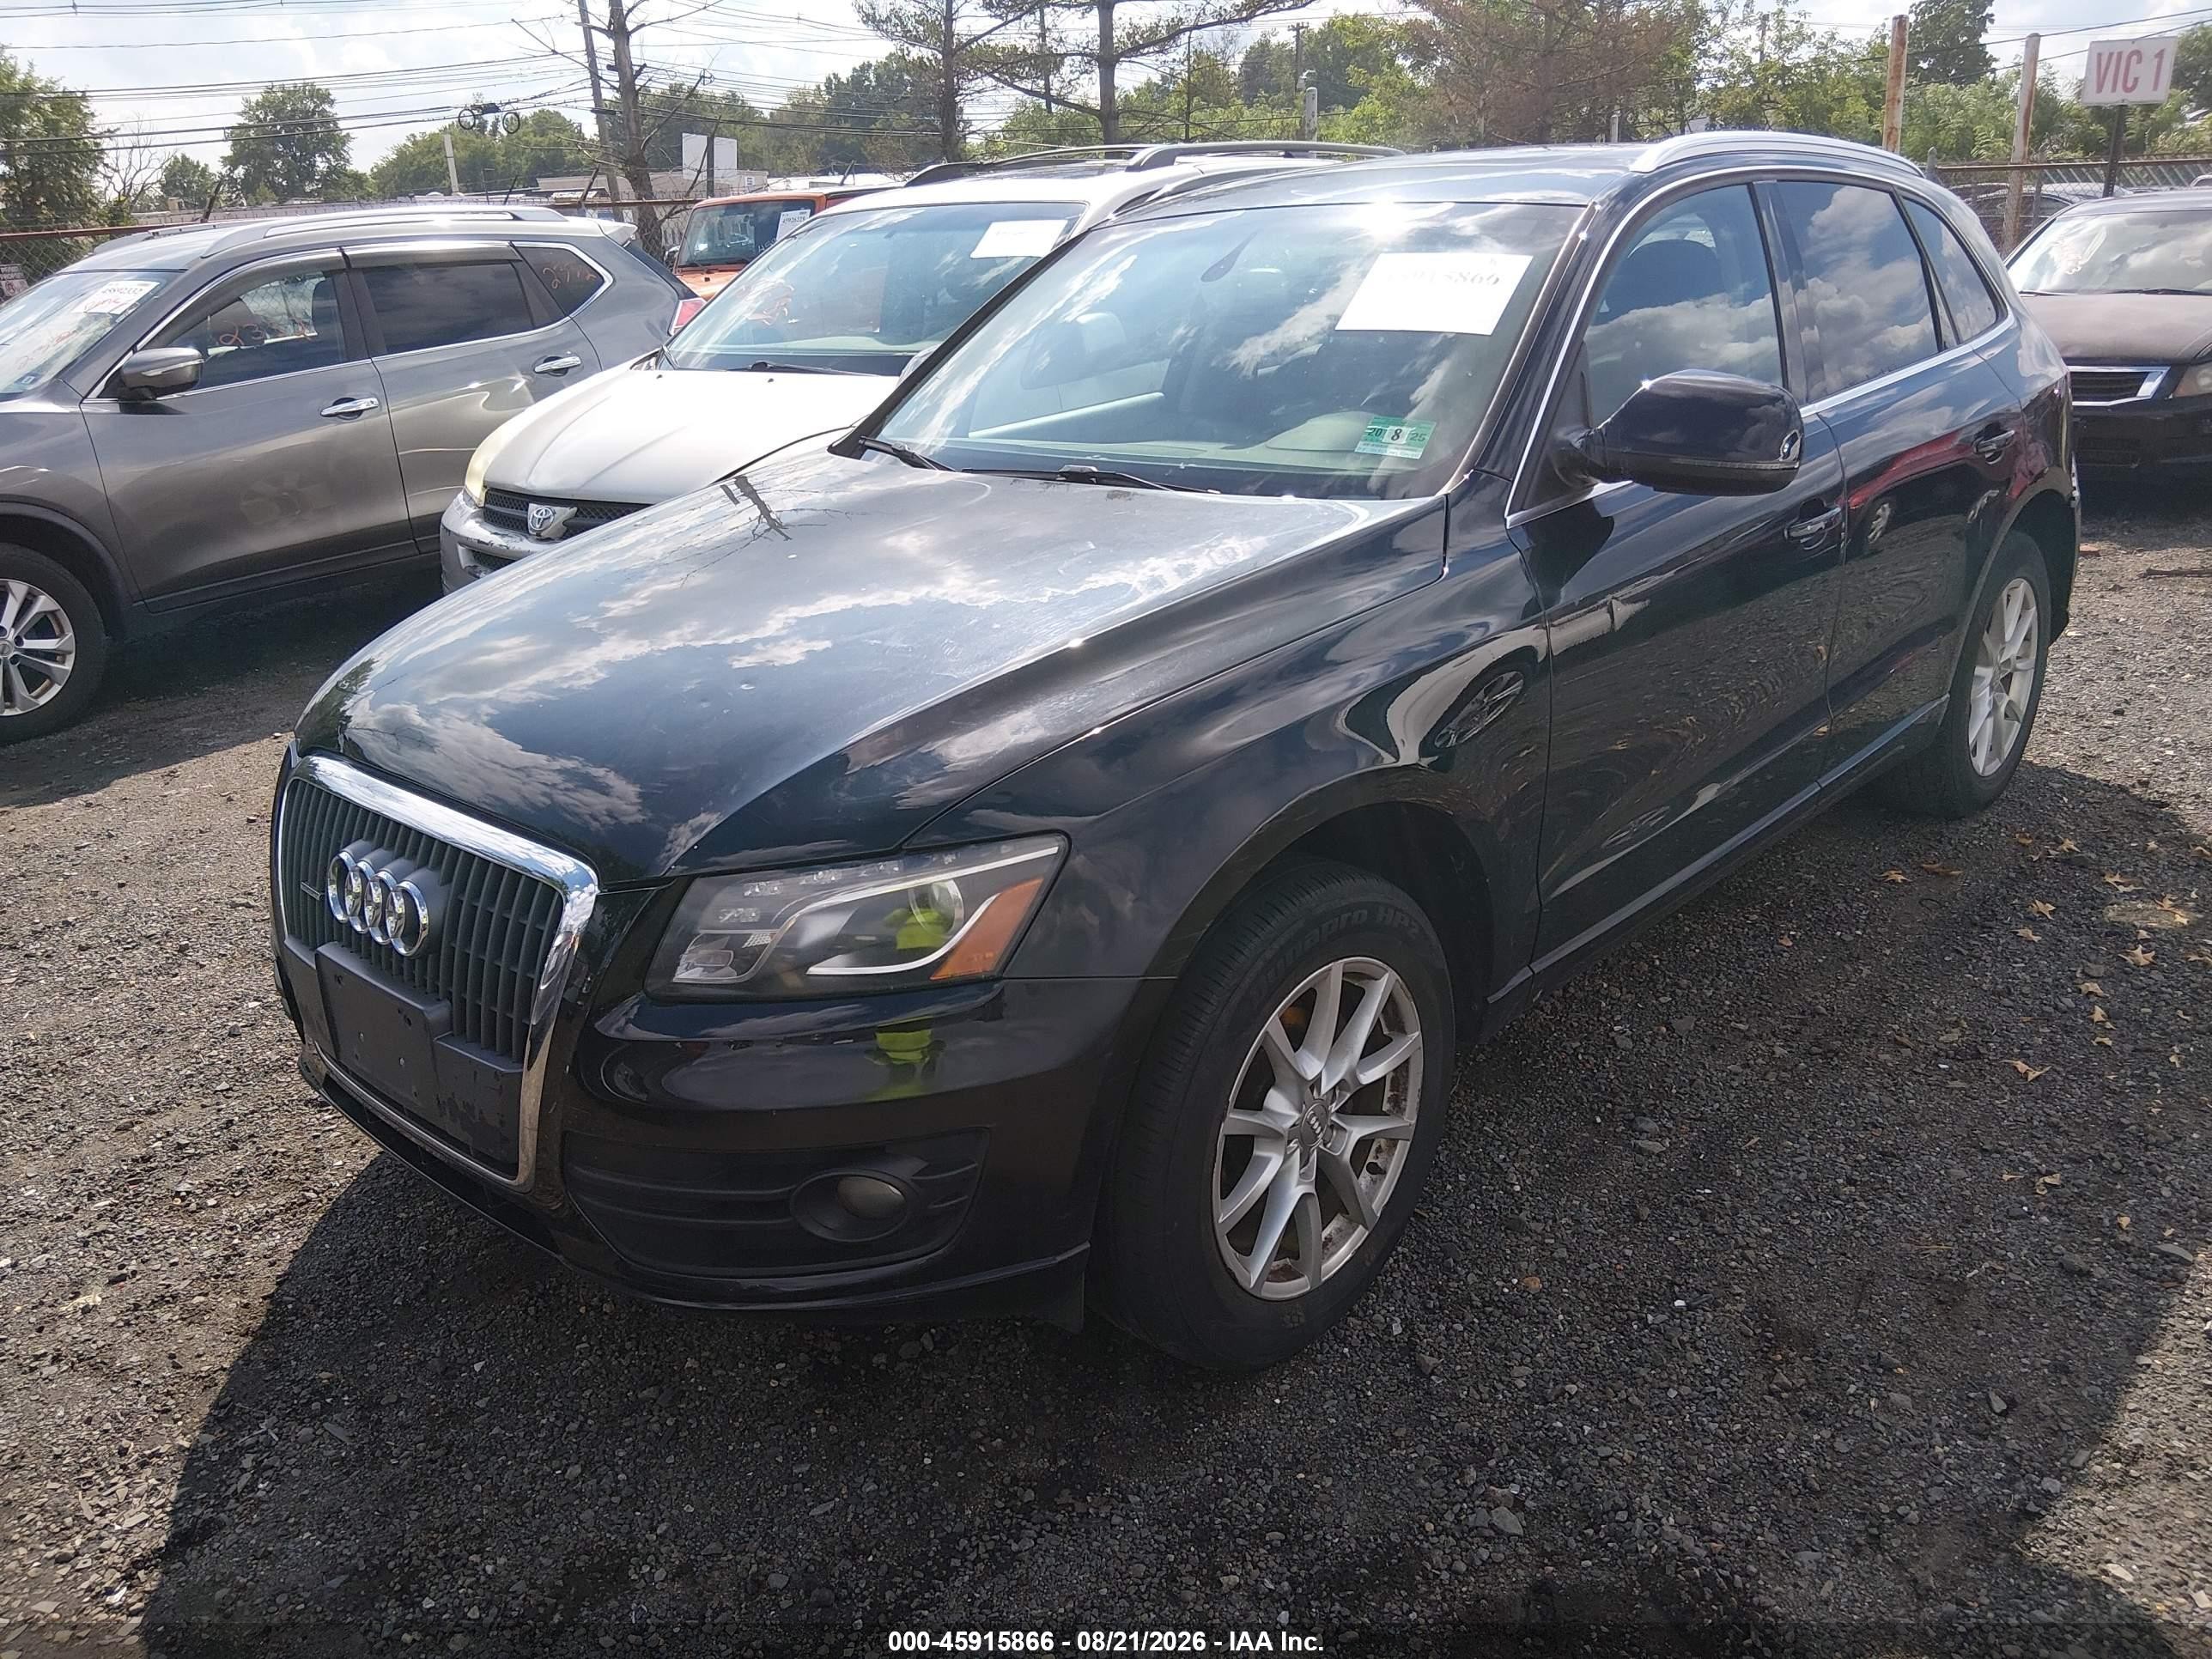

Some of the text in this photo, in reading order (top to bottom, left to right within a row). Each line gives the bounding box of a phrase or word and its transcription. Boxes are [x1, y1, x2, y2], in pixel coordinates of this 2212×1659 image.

[2096, 48, 2166, 94] VIC 1
[1367, 427, 1382, 437] 20
[1390, 428, 1402, 441] 8
[1409, 432, 1426, 441] 25
[1375, 904, 1419, 941] HP2
